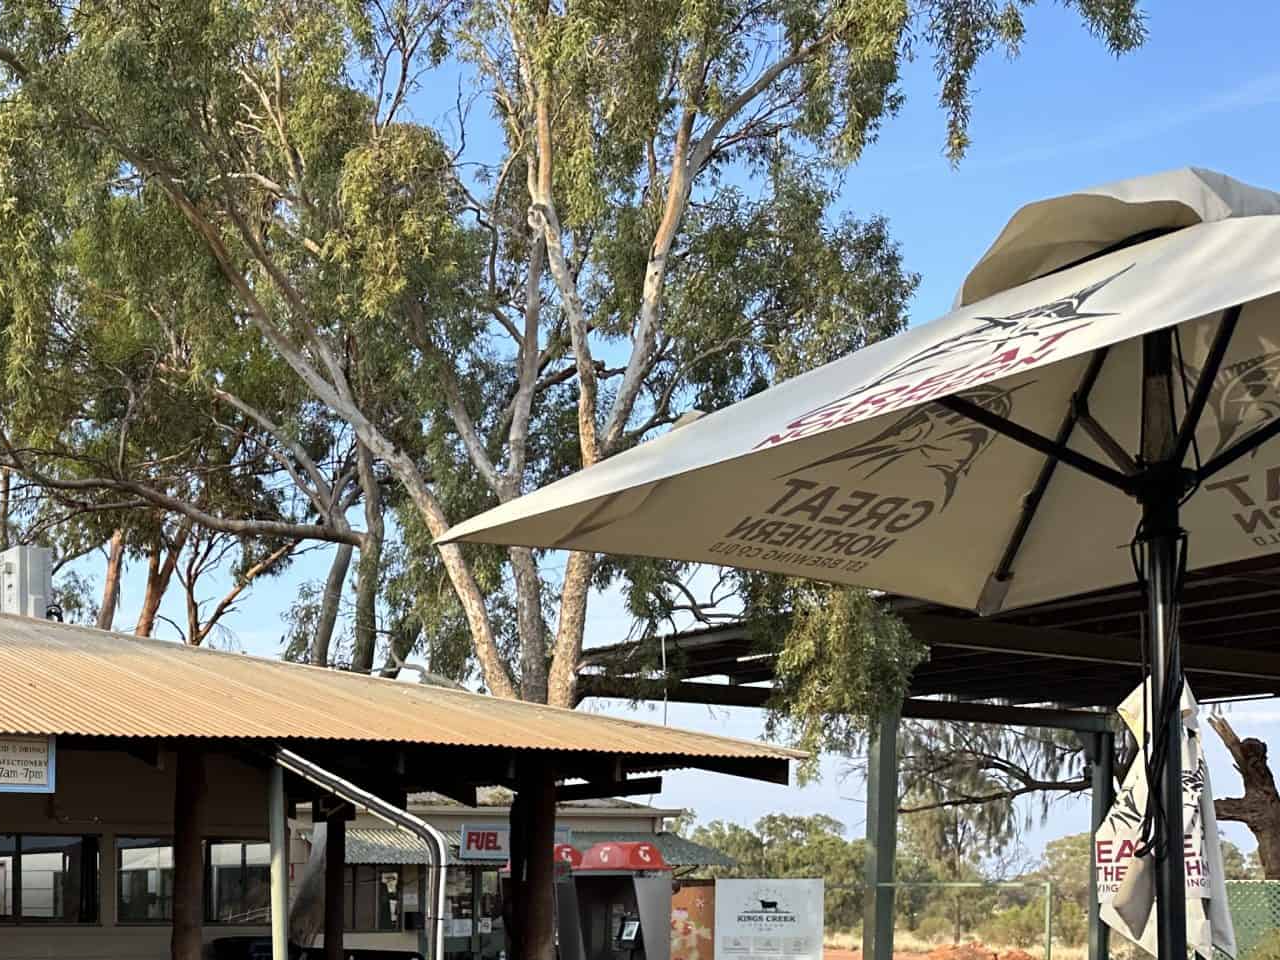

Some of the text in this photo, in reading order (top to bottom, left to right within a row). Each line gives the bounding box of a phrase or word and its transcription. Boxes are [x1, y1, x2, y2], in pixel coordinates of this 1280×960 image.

[786, 321, 1096, 430] GREAT
[0, 767, 18, 778] 7am
[466, 832, 502, 850] FUEL
